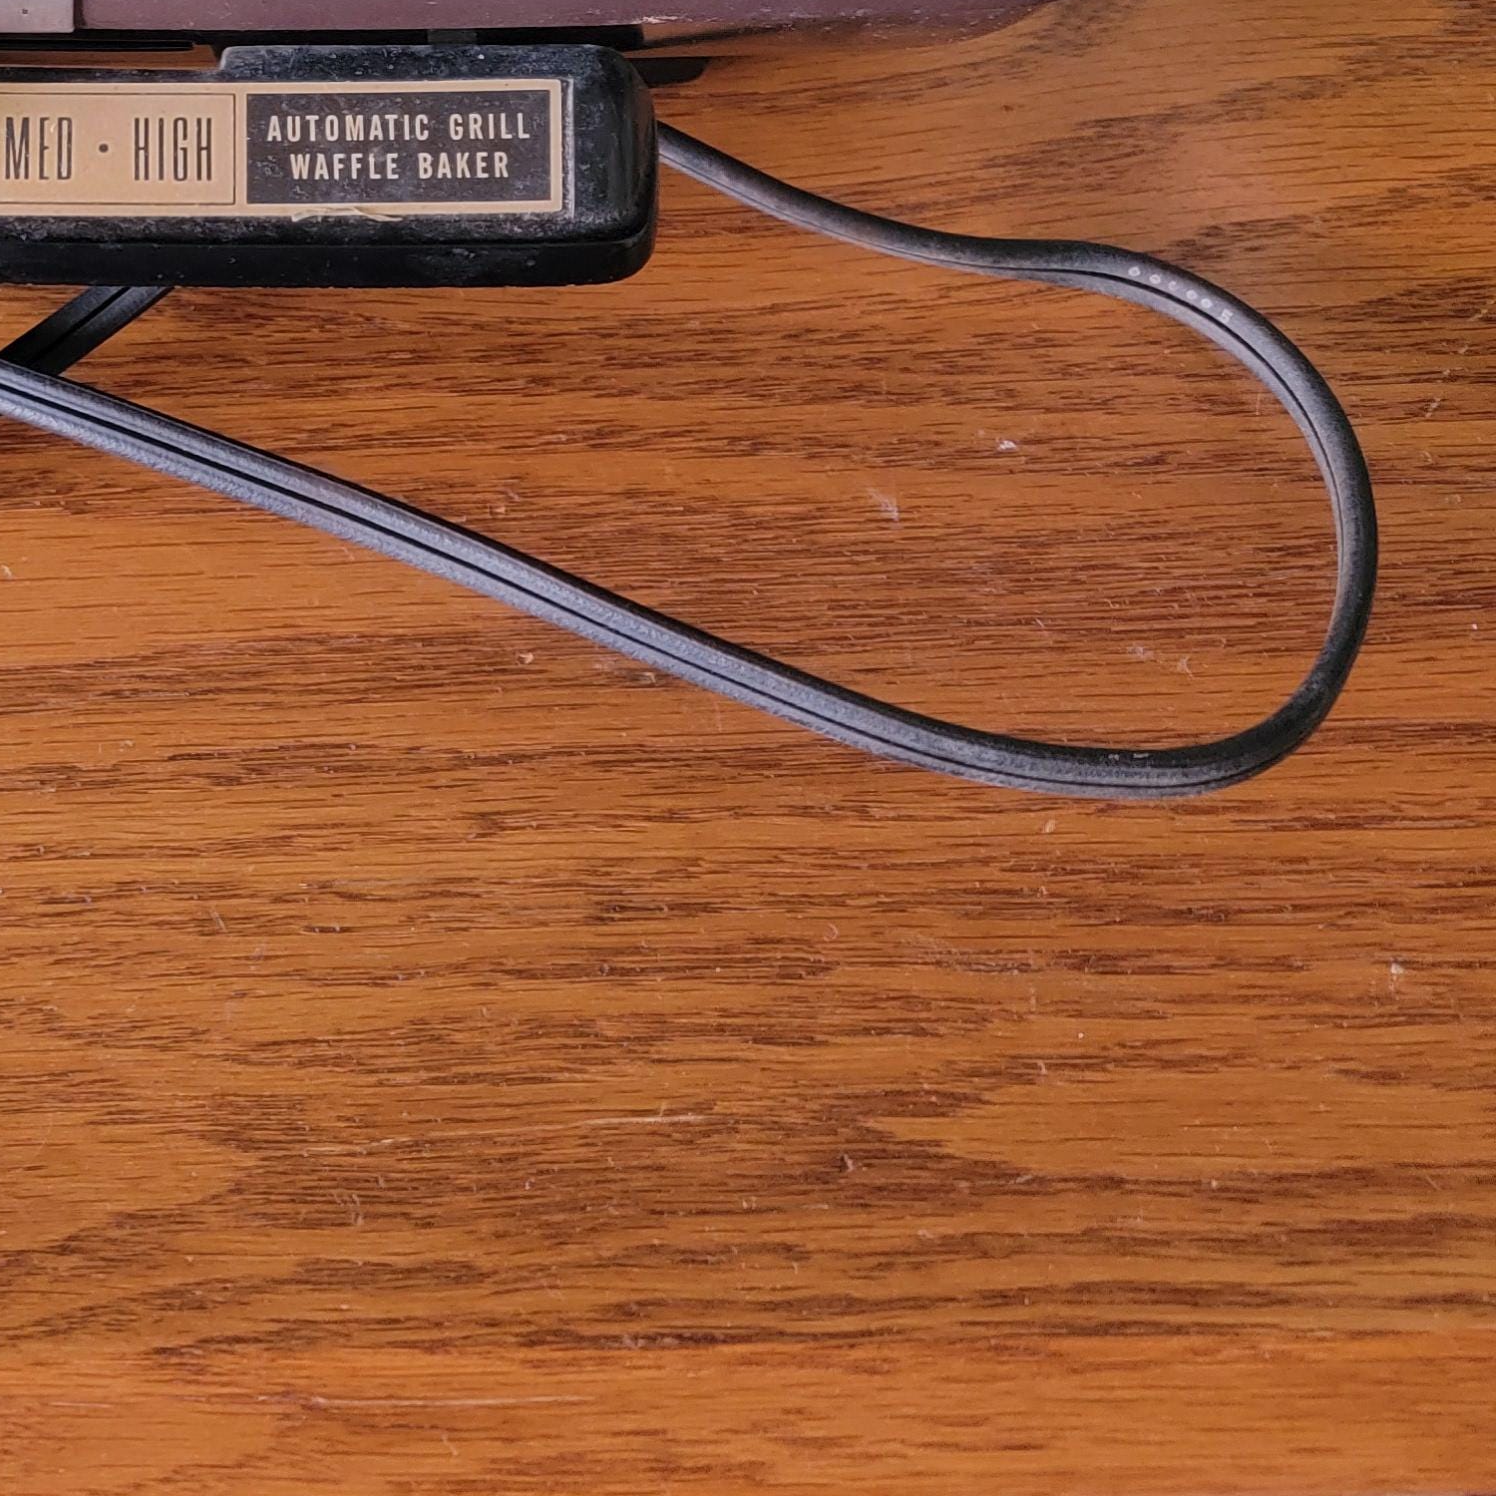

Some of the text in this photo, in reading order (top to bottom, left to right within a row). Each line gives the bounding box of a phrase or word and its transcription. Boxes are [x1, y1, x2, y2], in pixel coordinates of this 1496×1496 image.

[267, 112, 530, 142] AUTOMATIC GRILL
[5, 116, 73, 181] MED
[133, 116, 213, 181] HIGH
[290, 153, 509, 181] WAFFLE BAKER
